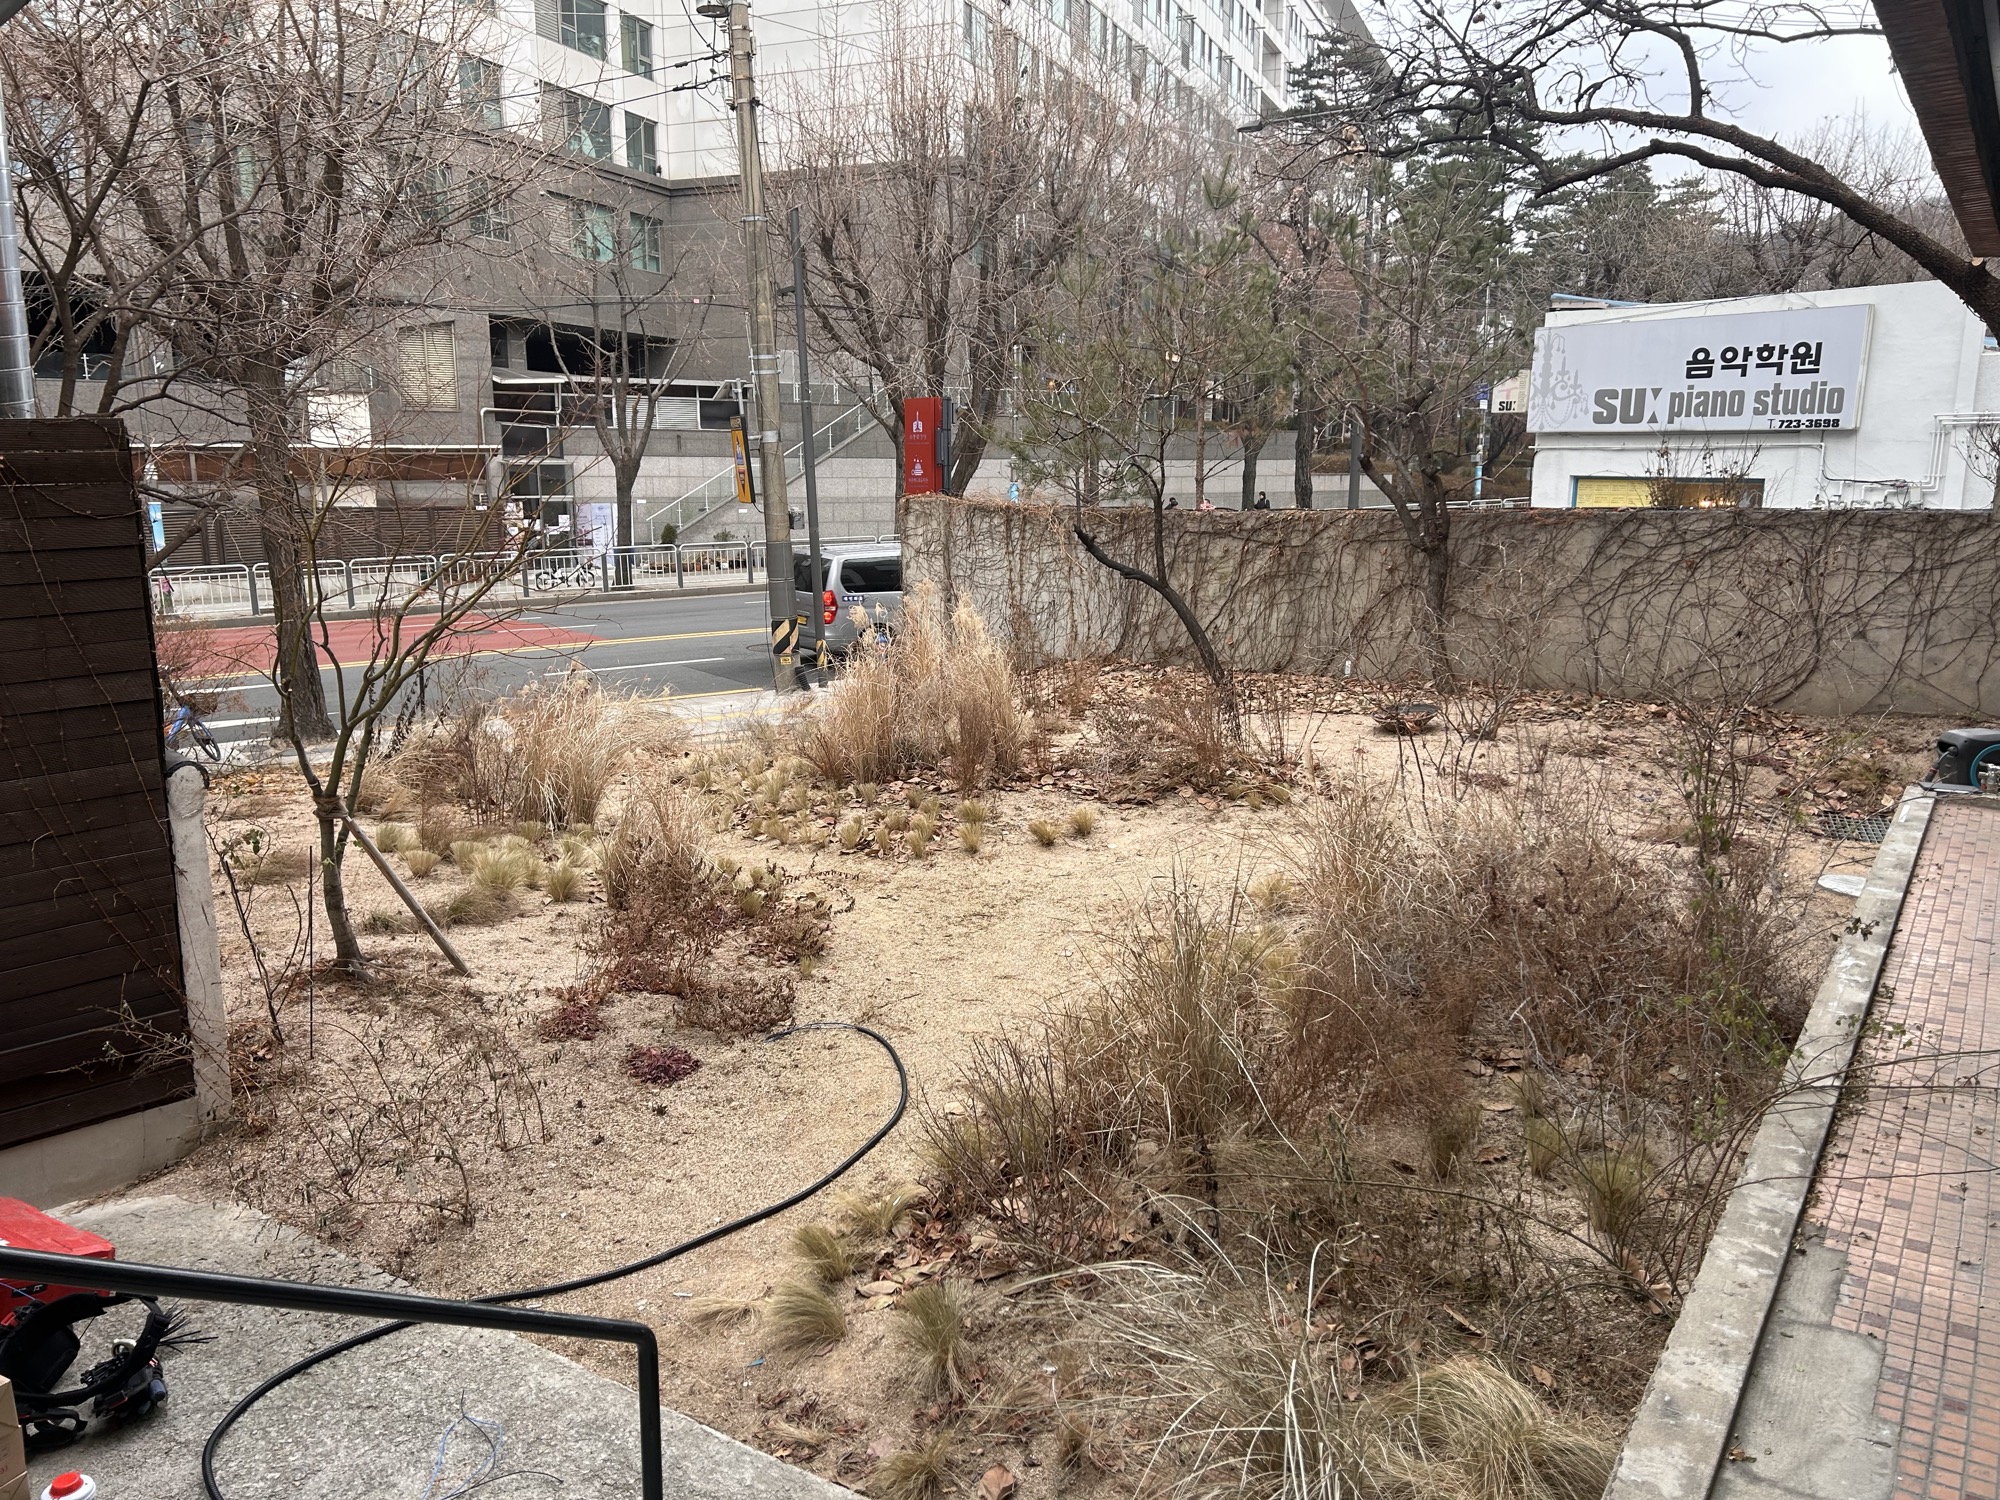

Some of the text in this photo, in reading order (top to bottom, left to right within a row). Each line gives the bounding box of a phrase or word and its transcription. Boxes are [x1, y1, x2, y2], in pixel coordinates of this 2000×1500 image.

[1685, 342, 1823, 379] 음악학원
[1667, 384, 1745, 424] piano
[1752, 380, 1845, 416] studio
